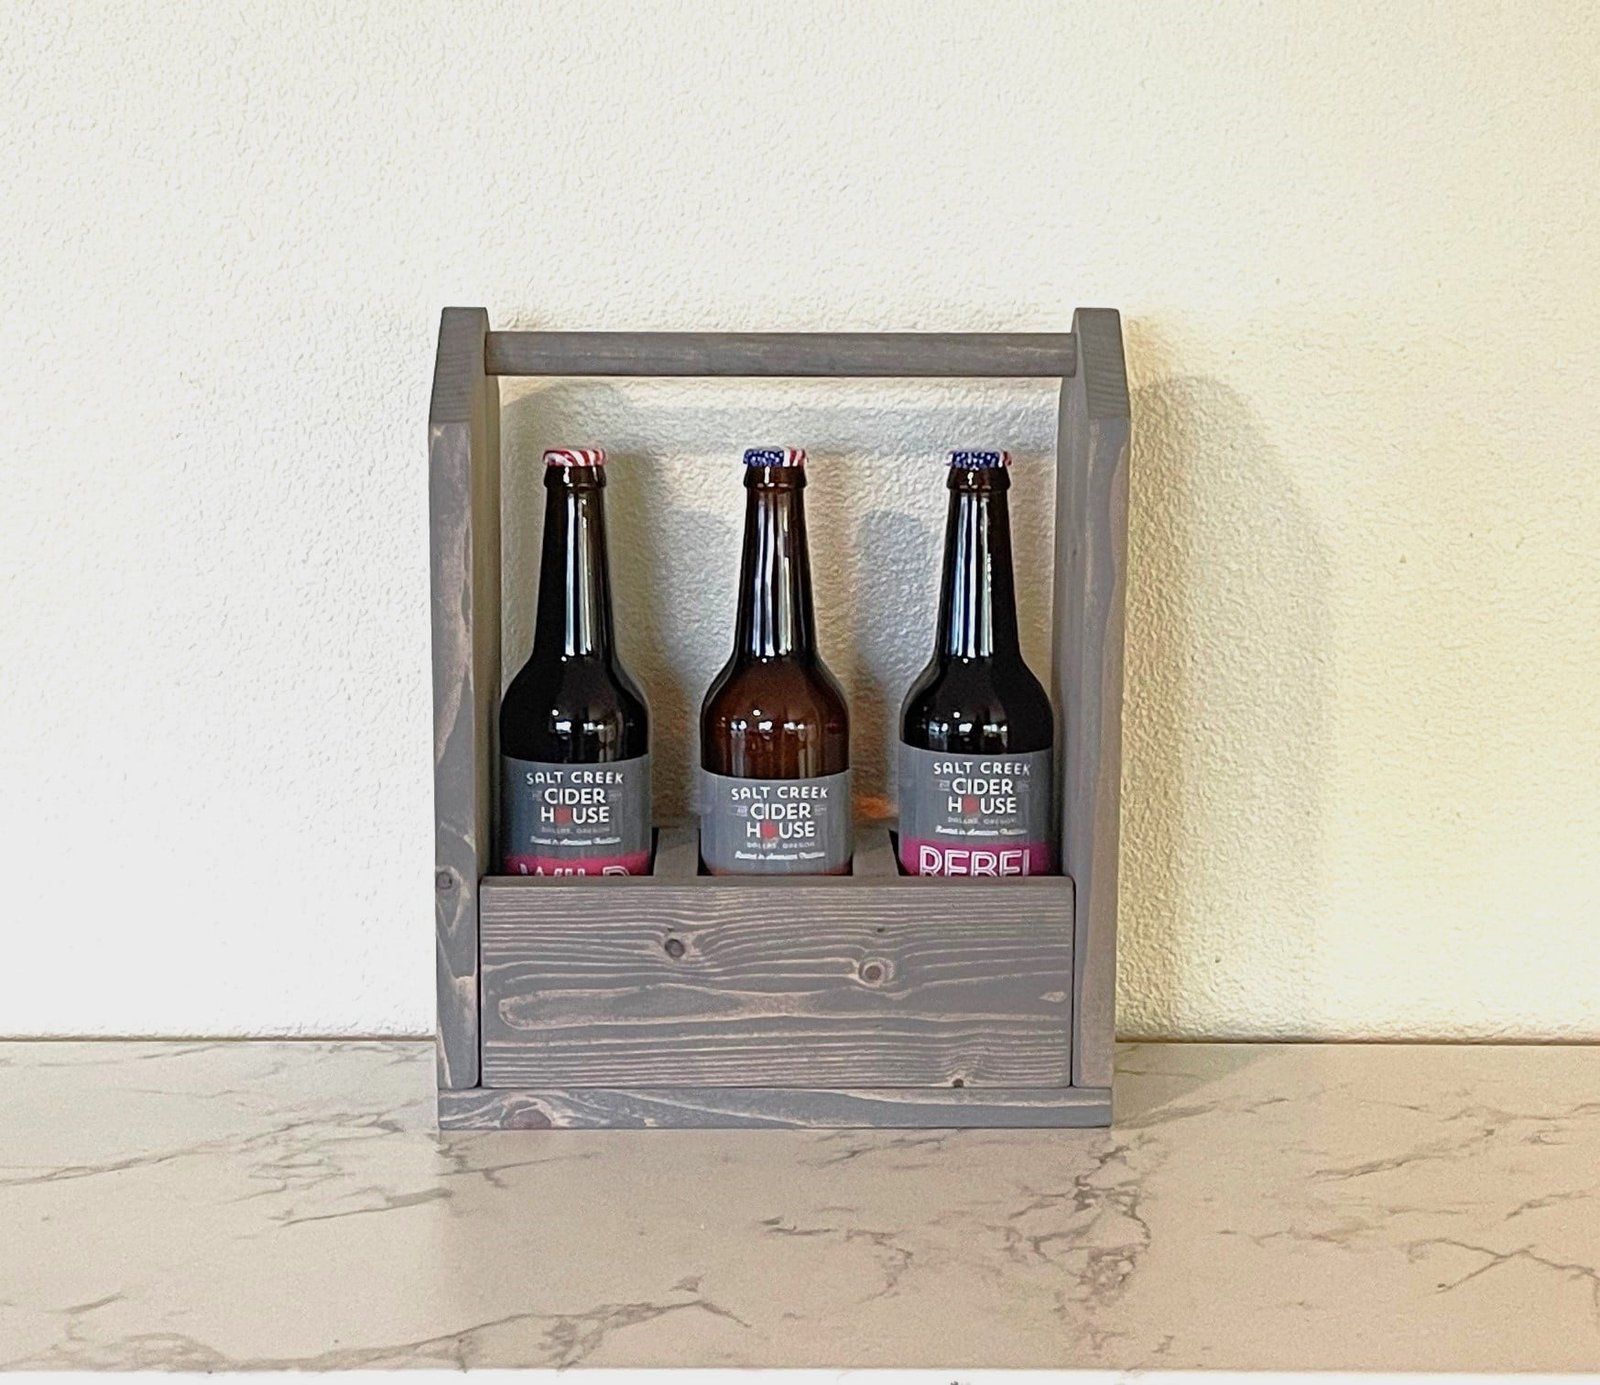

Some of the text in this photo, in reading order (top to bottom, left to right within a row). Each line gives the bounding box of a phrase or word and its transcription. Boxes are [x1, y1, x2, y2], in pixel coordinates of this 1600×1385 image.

[932, 761, 1031, 776] SALT CREEK
[526, 771, 624, 785] SALT CREEK
[952, 777, 1013, 795] CIDER
[544, 788, 606, 805] CIDER
[731, 786, 829, 800] SALT CREEK
[750, 802, 811, 820] CIDER
